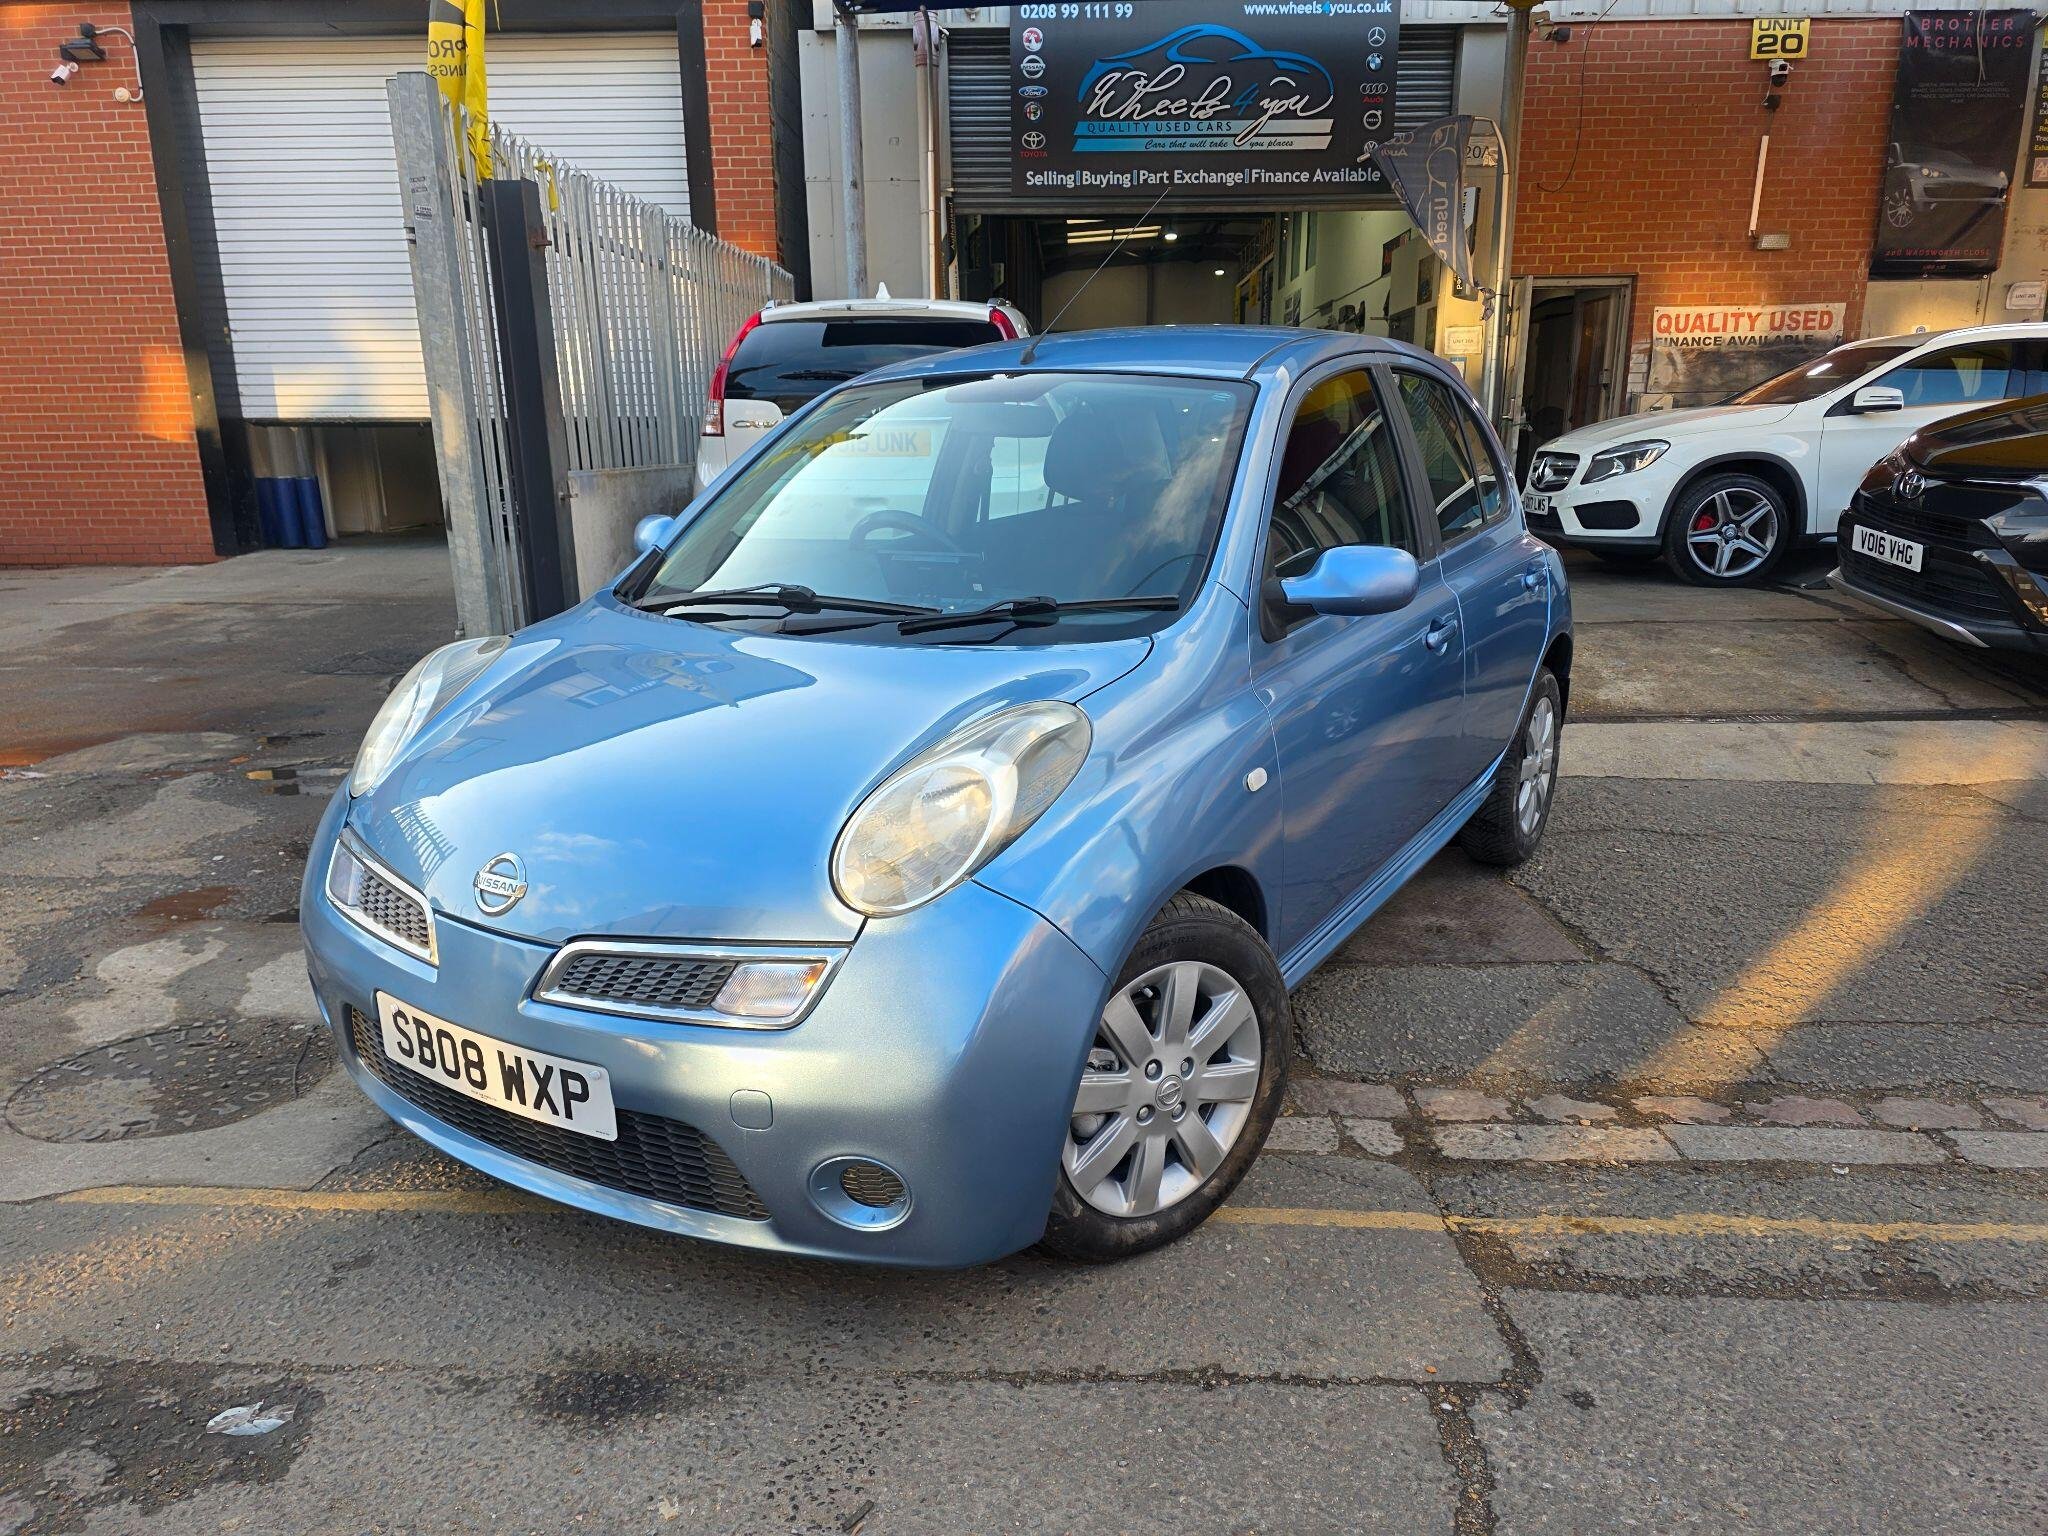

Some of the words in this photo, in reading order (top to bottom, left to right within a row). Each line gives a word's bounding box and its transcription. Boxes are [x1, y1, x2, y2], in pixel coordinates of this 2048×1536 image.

[1020, 4, 1057, 19] 0208
[1061, 4, 1079, 18] 99
[1084, 4, 1110, 18] 111
[1115, 4, 1133, 18] 99
[1244, 0, 1393, 17] www.wheels4you.co.uk
[1758, 19, 1806, 32] UNIT
[1756, 33, 1804, 55] 20
[1906, 35, 2025, 49] MECHANICS
[1086, 64, 1231, 120] Wheels
[1233, 83, 1260, 117] 4
[1087, 121, 1150, 134] QUALITY
[1155, 121, 1191, 133] USED
[1196, 120, 1232, 132] CARS
[1235, 88, 1335, 146] you
[1144, 139, 1167, 150] Cars
[1168, 138, 1188, 148] that
[1189, 138, 1208, 148] will
[1209, 138, 1229, 147] take
[1248, 140, 1265, 150] you
[1266, 138, 1295, 148] places
[1026, 170, 1075, 189] Selling
[1082, 170, 1132, 188] Buying
[1138, 170, 1170, 184] Part
[1173, 169, 1243, 187] Exchange
[1251, 168, 1309, 183] Finance
[1312, 167, 1381, 183] Available
[1655, 312, 1763, 335] QUALITY
[1769, 310, 1835, 332] USED
[1655, 335, 1723, 347] FINANCE
[1726, 334, 1815, 347] AVAILABLE
[876, 431, 918, 453] UNK
[1860, 529, 1886, 556] VO16
[1888, 539, 1914, 565] VHG
[476, 873, 518, 894] NISSAN
[392, 1009, 488, 1092] SB08
[496, 1048, 590, 1121] WXP
